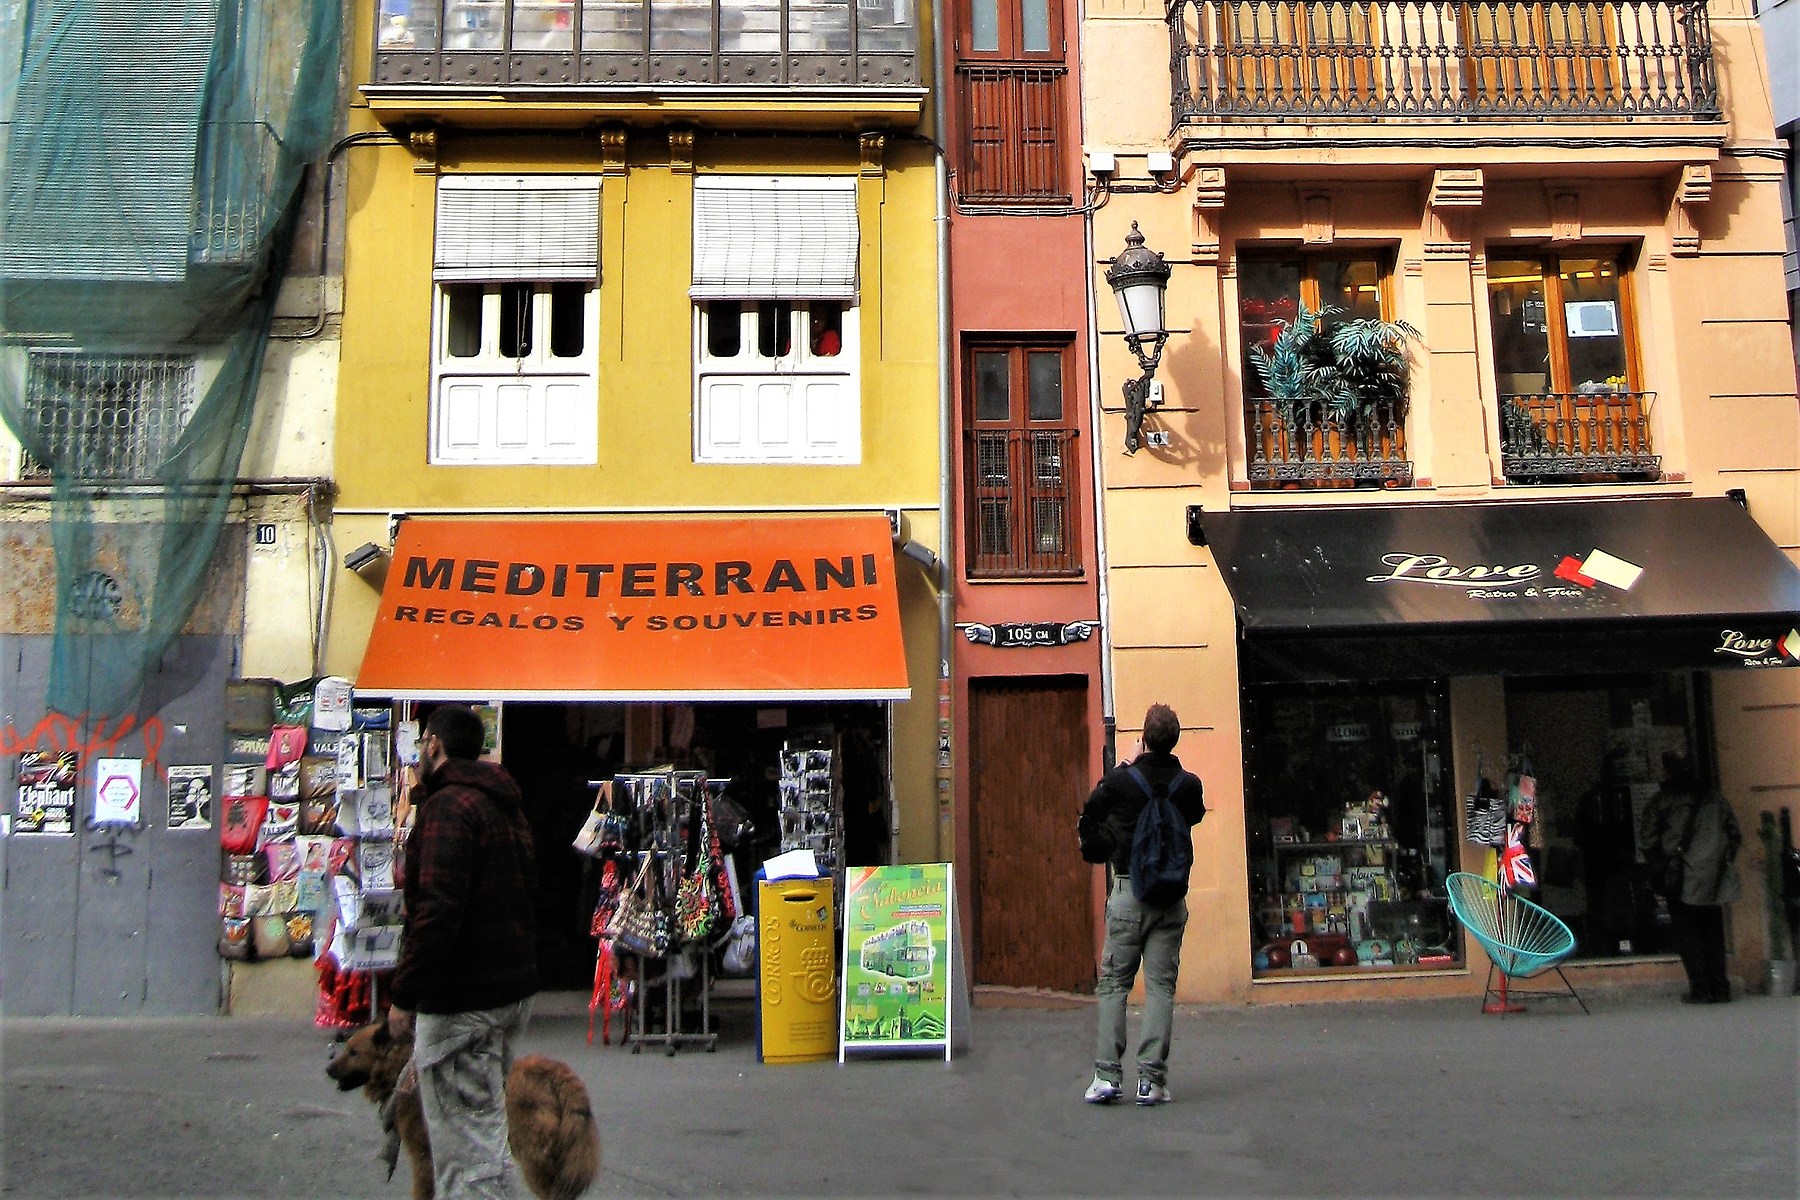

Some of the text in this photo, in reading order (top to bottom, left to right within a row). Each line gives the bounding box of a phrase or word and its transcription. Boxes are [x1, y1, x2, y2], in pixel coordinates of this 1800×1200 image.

[260, 526, 275, 543] 10
[402, 553, 878, 598] MEDITERRANI
[1365, 552, 1541, 587] Love
[1466, 586, 1583, 599] Retro & Fun
[394, 604, 878, 632] REGALOS Y SOUVENIRS
[1007, 628, 1032, 640] 105
[1713, 629, 1772, 656] Love
[19, 785, 76, 807] Elephant
